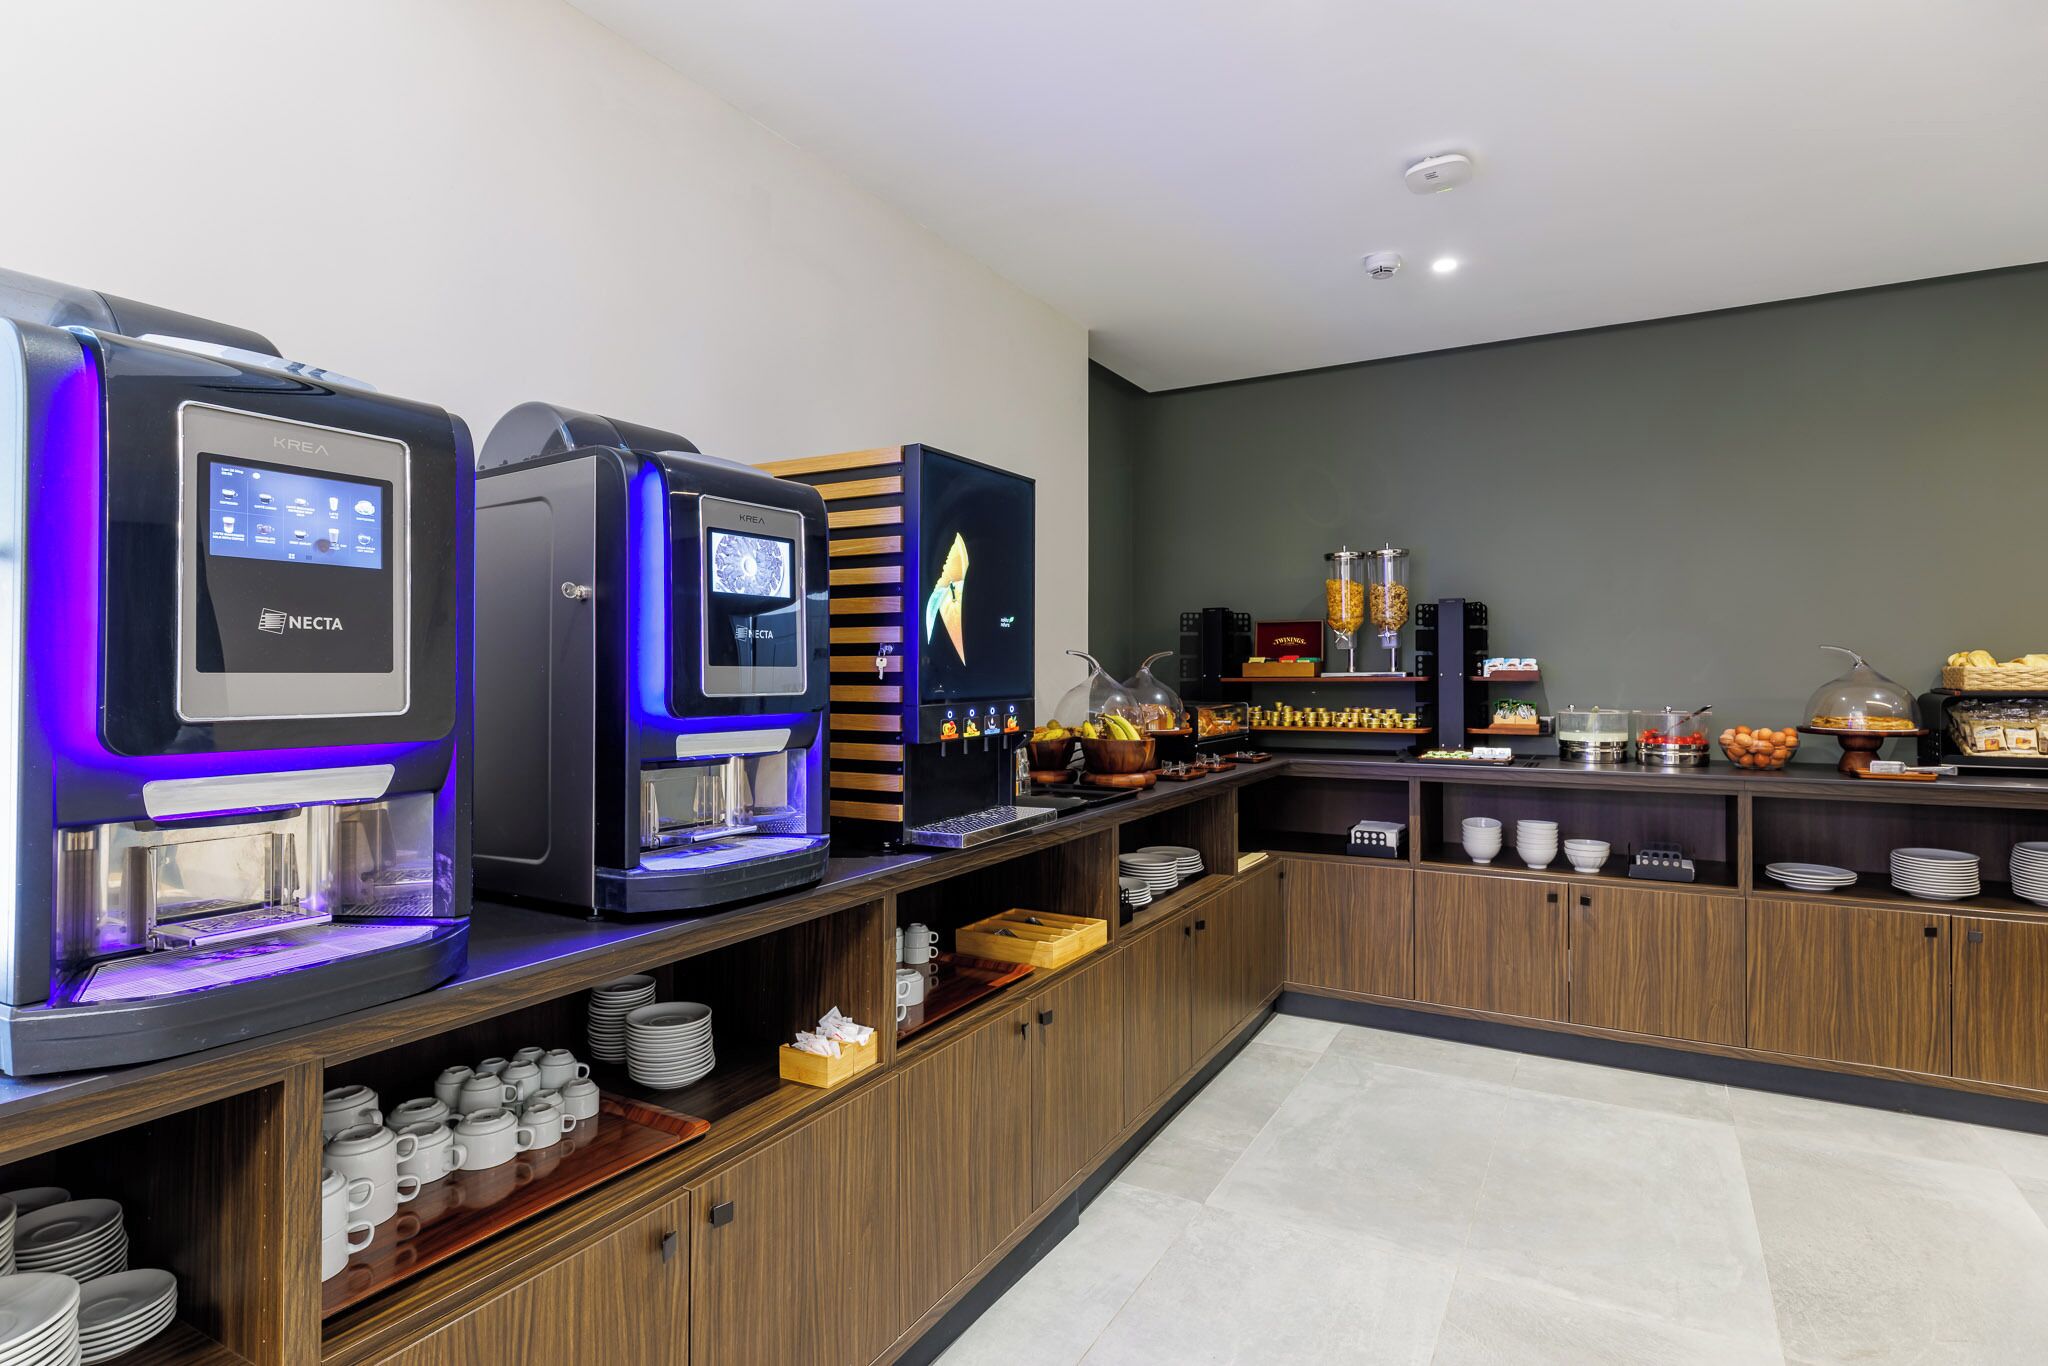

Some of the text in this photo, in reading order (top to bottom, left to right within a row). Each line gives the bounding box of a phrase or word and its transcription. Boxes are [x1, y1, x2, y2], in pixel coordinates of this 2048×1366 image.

[273, 436, 329, 457] KREA
[739, 514, 765, 525] KREA
[289, 615, 343, 631] NECTA
[748, 629, 774, 639] NECTA
[1274, 636, 1305, 645] TWININGS
